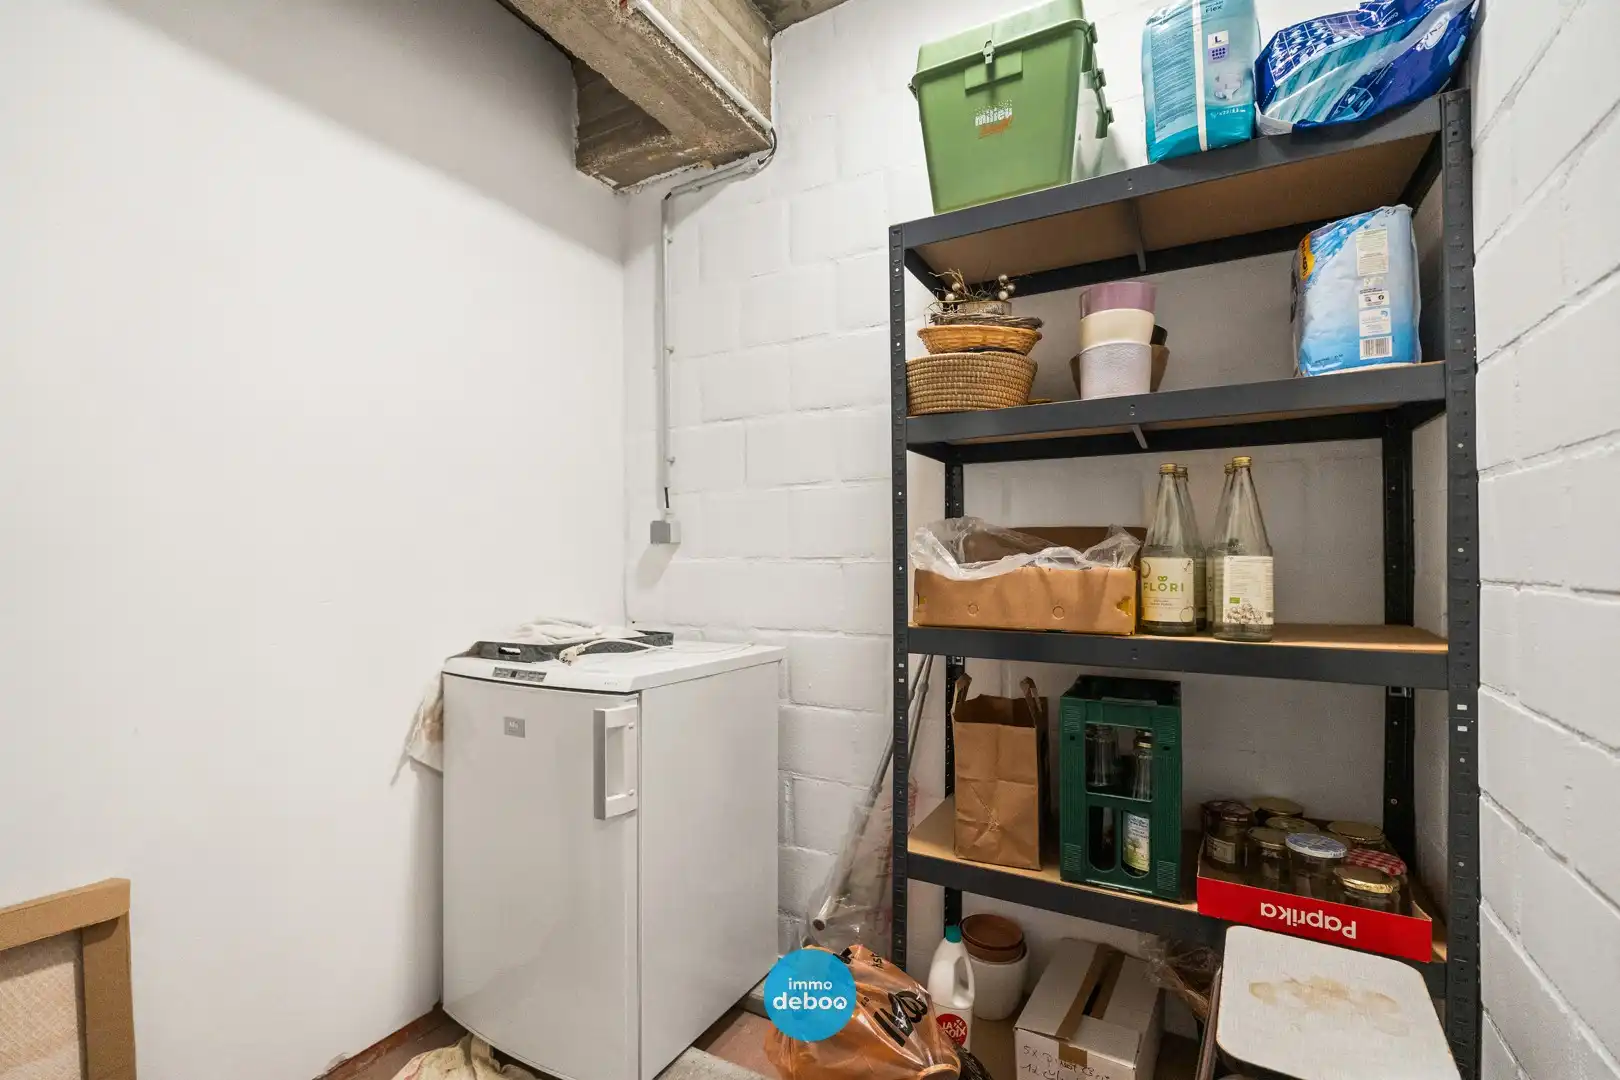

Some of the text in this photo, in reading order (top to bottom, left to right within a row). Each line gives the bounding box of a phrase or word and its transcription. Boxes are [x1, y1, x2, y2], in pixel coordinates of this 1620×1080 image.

[1214, 35, 1222, 43] L
[1143, 582, 1184, 592] FLORI
[1260, 902, 1357, 940] Paprika
[942, 1021, 953, 1030] LA
